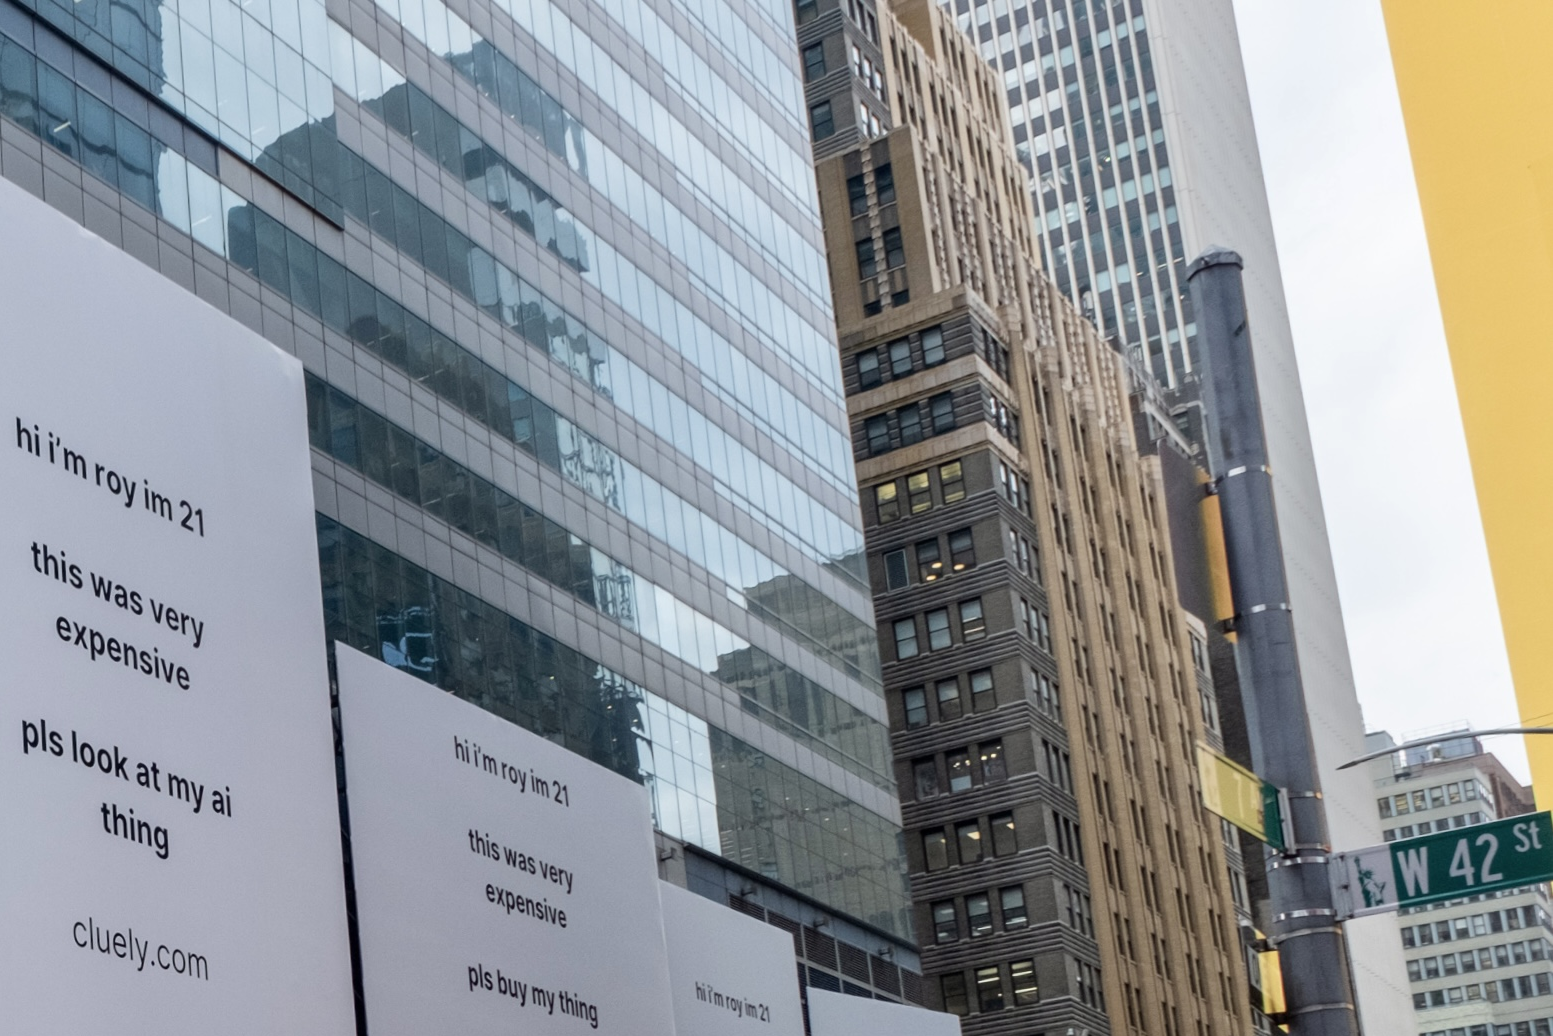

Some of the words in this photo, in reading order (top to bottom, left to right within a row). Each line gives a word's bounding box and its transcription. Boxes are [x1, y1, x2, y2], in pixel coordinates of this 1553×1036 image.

[16, 417, 40, 457] hi
[49, 432, 87, 479] i'm
[95, 463, 136, 508] roy
[144, 479, 172, 521] im
[180, 500, 204, 537] 21
[31, 542, 83, 589] this
[90, 572, 143, 615] was
[150, 599, 204, 648] very
[56, 616, 190, 690] expensive
[22, 719, 63, 756] pls
[72, 730, 129, 781] look
[136, 762, 161, 792] at
[168, 773, 204, 814] my
[212, 786, 231, 817] ai
[454, 736, 470, 763] hi
[473, 744, 497, 775] i'm
[502, 762, 526, 793] roy
[531, 769, 549, 798] im
[553, 780, 569, 807] 21
[101, 803, 169, 859] thing
[468, 829, 500, 861] this
[504, 847, 536, 875] was
[539, 861, 572, 894] very
[1397, 847, 1429, 897] W
[1449, 833, 1503, 886] 42
[1513, 821, 1542, 852] St
[486, 884, 567, 928] expensive
[73, 917, 209, 980] cluely.com
[468, 964, 493, 991] pls
[497, 970, 527, 1007] buy
[532, 987, 554, 1015] my
[559, 991, 598, 1029] thing
